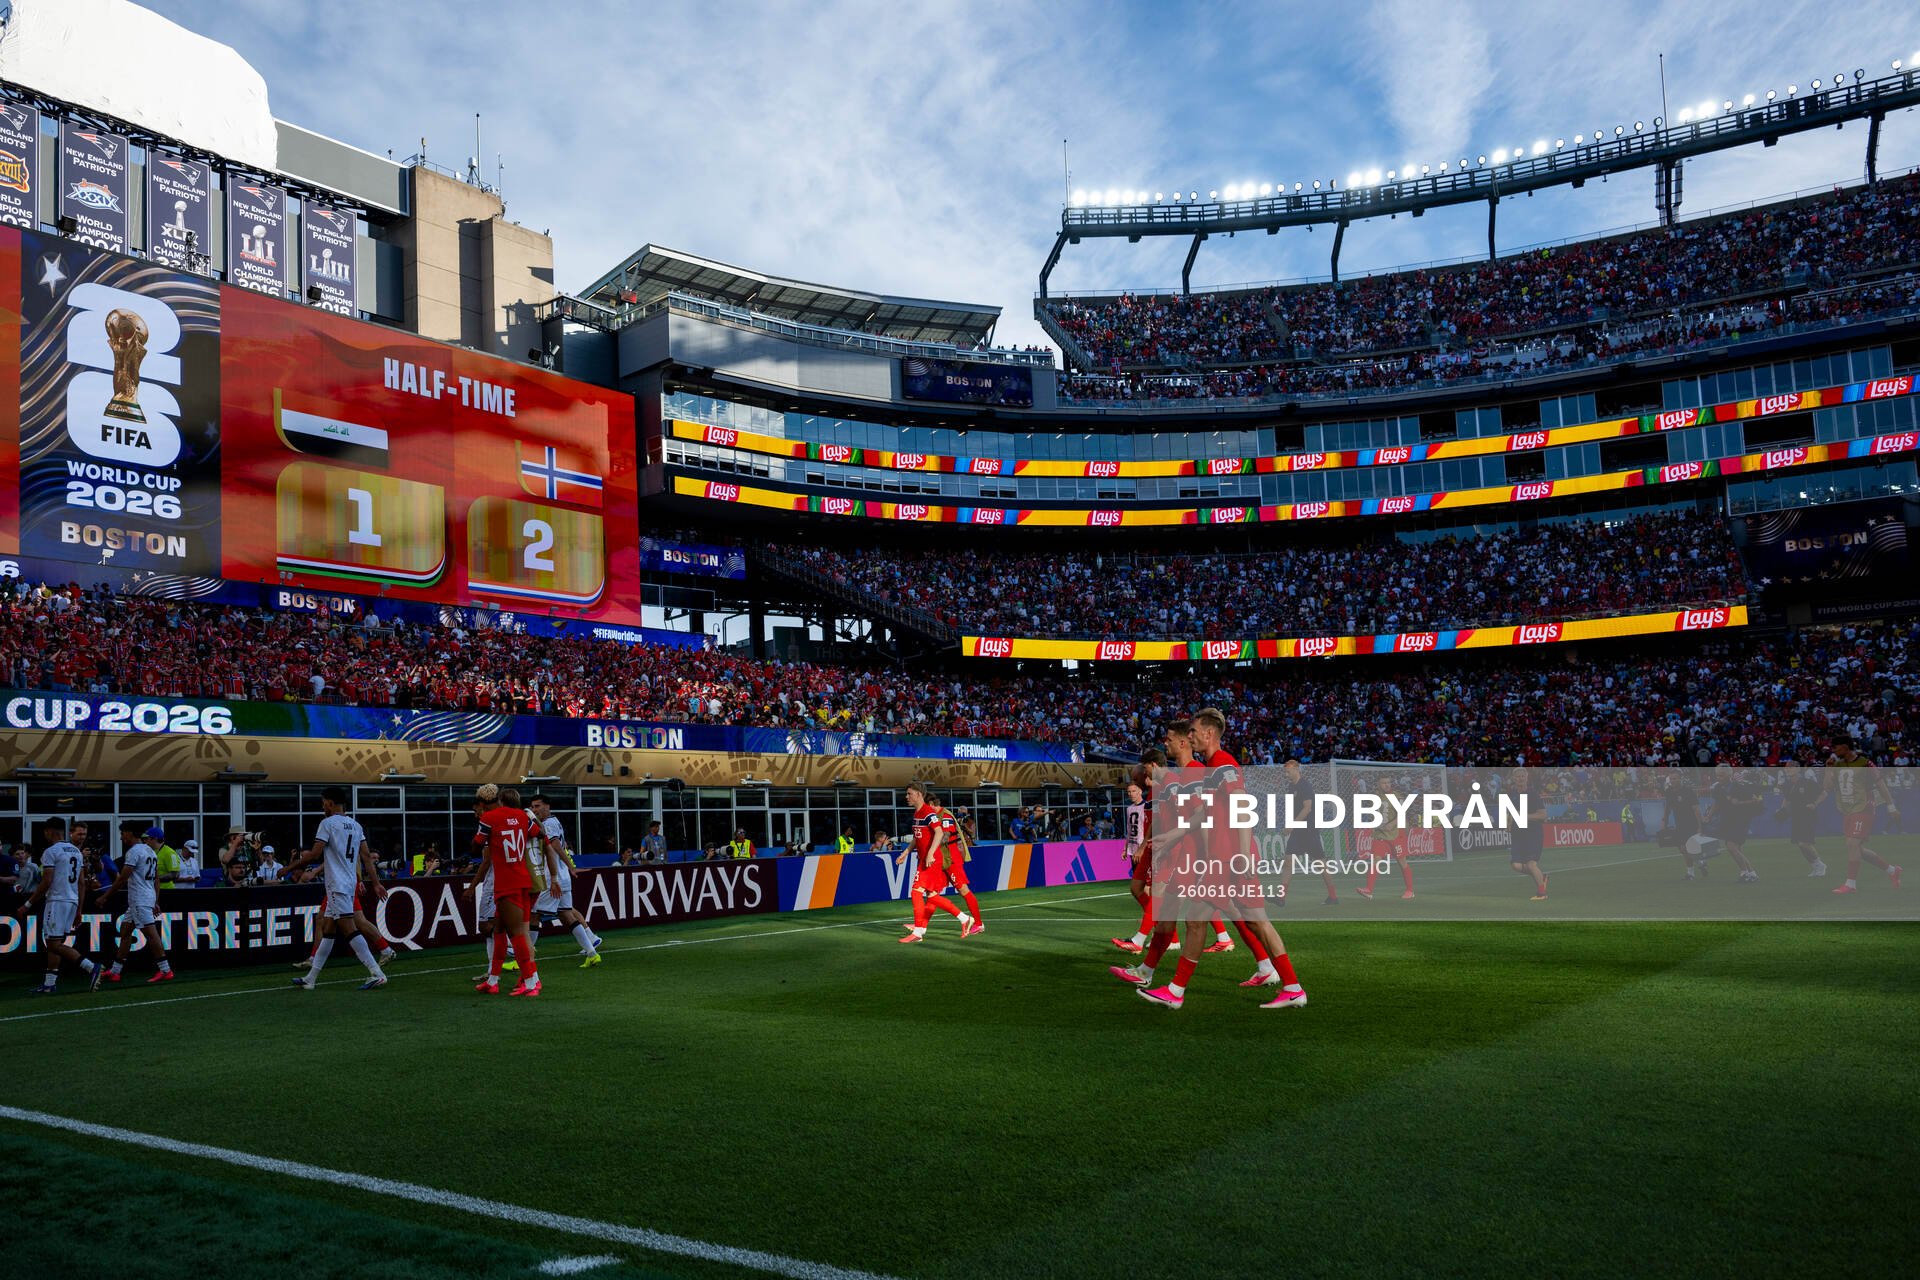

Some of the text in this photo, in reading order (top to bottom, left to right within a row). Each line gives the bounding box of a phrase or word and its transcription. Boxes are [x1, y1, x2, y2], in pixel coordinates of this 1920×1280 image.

[0, 135, 26, 149] RIOTS
[66, 146, 124, 171] NEW ENGLAND
[73, 157, 117, 177] PATRIOTS
[152, 174, 207, 197] NEW ENGLAND
[159, 183, 200, 203] PATRIOTS
[1, 194, 22, 206] RLD
[233, 200, 282, 220] NEW ENGLAND
[76, 214, 113, 231] WORLD
[239, 209, 277, 226] PATRIOTS
[76, 225, 124, 244] HAMPIONS
[307, 223, 353, 242] NEW ENGLAND
[312, 232, 348, 248] PATRIOTS
[163, 238, 186, 251] WOR
[233, 268, 283, 288] CHAMPIONS
[242, 261, 274, 276] WORLD
[320, 293, 353, 307] AMPIONS
[384, 357, 516, 418] HALF-TIME
[946, 375, 992, 388] BOSTON
[101, 424, 152, 450] FIFA
[66, 460, 182, 492] WORLD CUP
[66, 481, 182, 519] 2026
[348, 487, 382, 547] 1
[61, 521, 186, 557] BOSTON
[523, 519, 555, 572] 2
[1784, 531, 1868, 552] BOSTON
[663, 550, 719, 567] BOSTON
[5, 697, 234, 735] CUP 2026
[587, 724, 683, 750] BOSTON
[954, 744, 1007, 761] #FIFAWorldCup
[501, 828, 525, 863] 20
[1554, 826, 1594, 845] Lenovo
[346, 834, 354, 863] 4
[69, 856, 78, 883] 3
[585, 864, 762, 923] AIRWAYS
